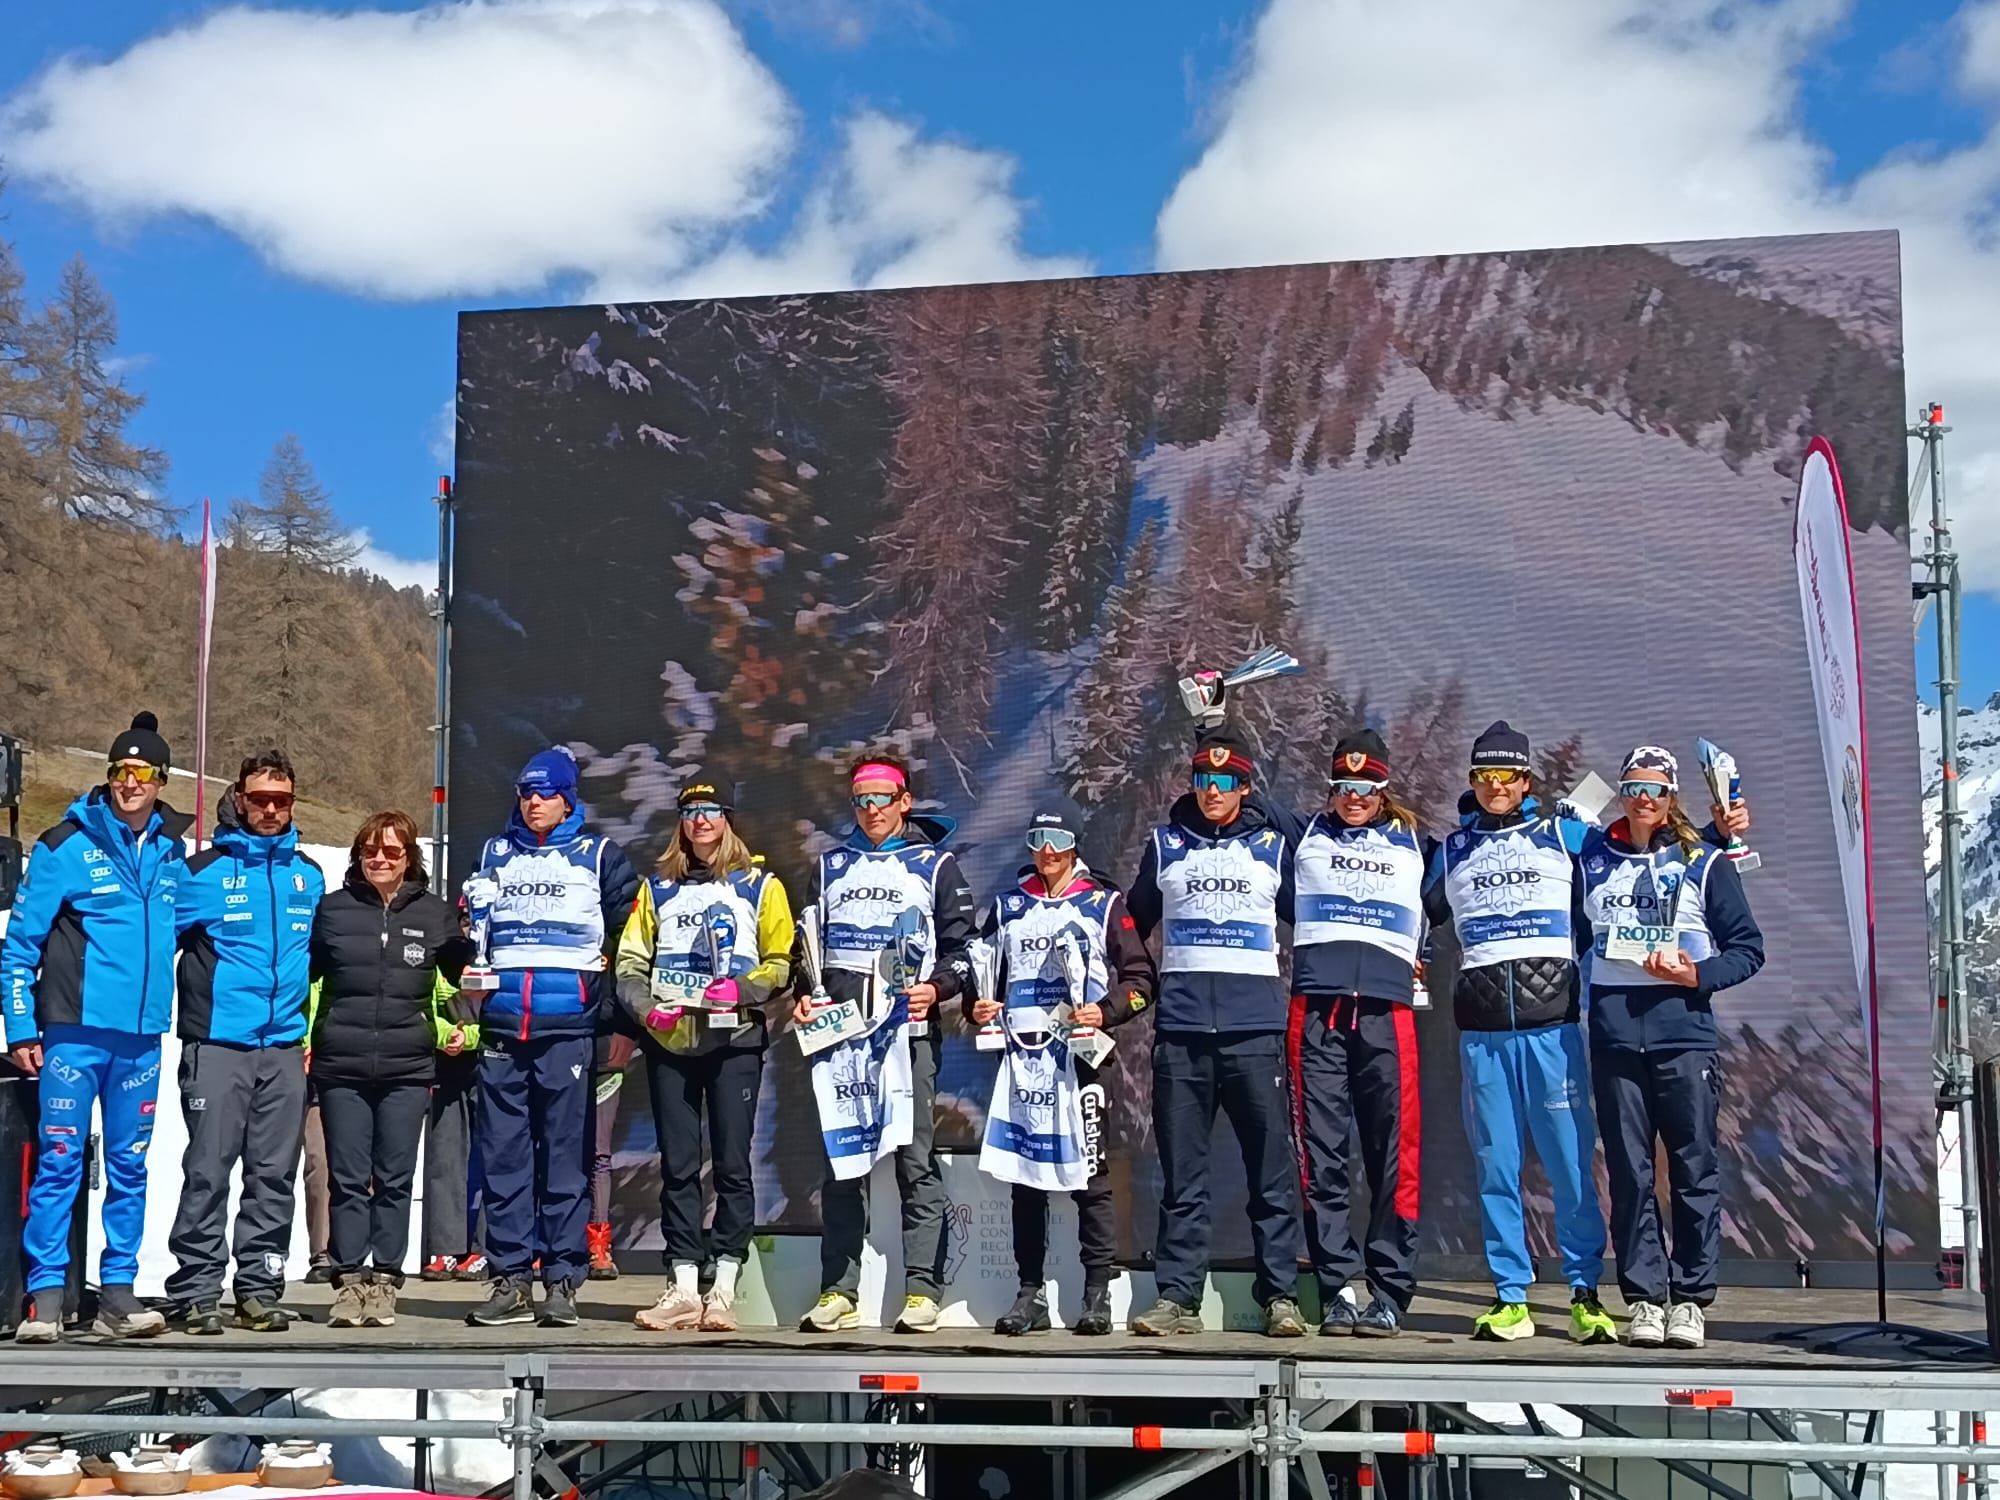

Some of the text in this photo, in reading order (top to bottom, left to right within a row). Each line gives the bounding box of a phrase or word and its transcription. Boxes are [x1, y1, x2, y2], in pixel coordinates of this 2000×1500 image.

[1330, 855, 1396, 876] RODE
[1186, 878, 1252, 894] RODE
[1472, 870, 1541, 891] RODE
[502, 882, 567, 898] RODE
[840, 887, 903, 903] RODE
[677, 912, 704, 928] RO
[1209, 927, 1237, 936] coppa
[1616, 926, 1674, 943] RODE
[1020, 937, 1056, 951] RO
[658, 969, 711, 990] RODE
[12, 978, 26, 1015] Audi
[801, 1003, 855, 1037] RODE
[49, 1056, 82, 1083] EA7
[189, 1098, 206, 1108] EA7
[1016, 1088, 1057, 1106] ODE
[981, 1215, 997, 1225] DE
